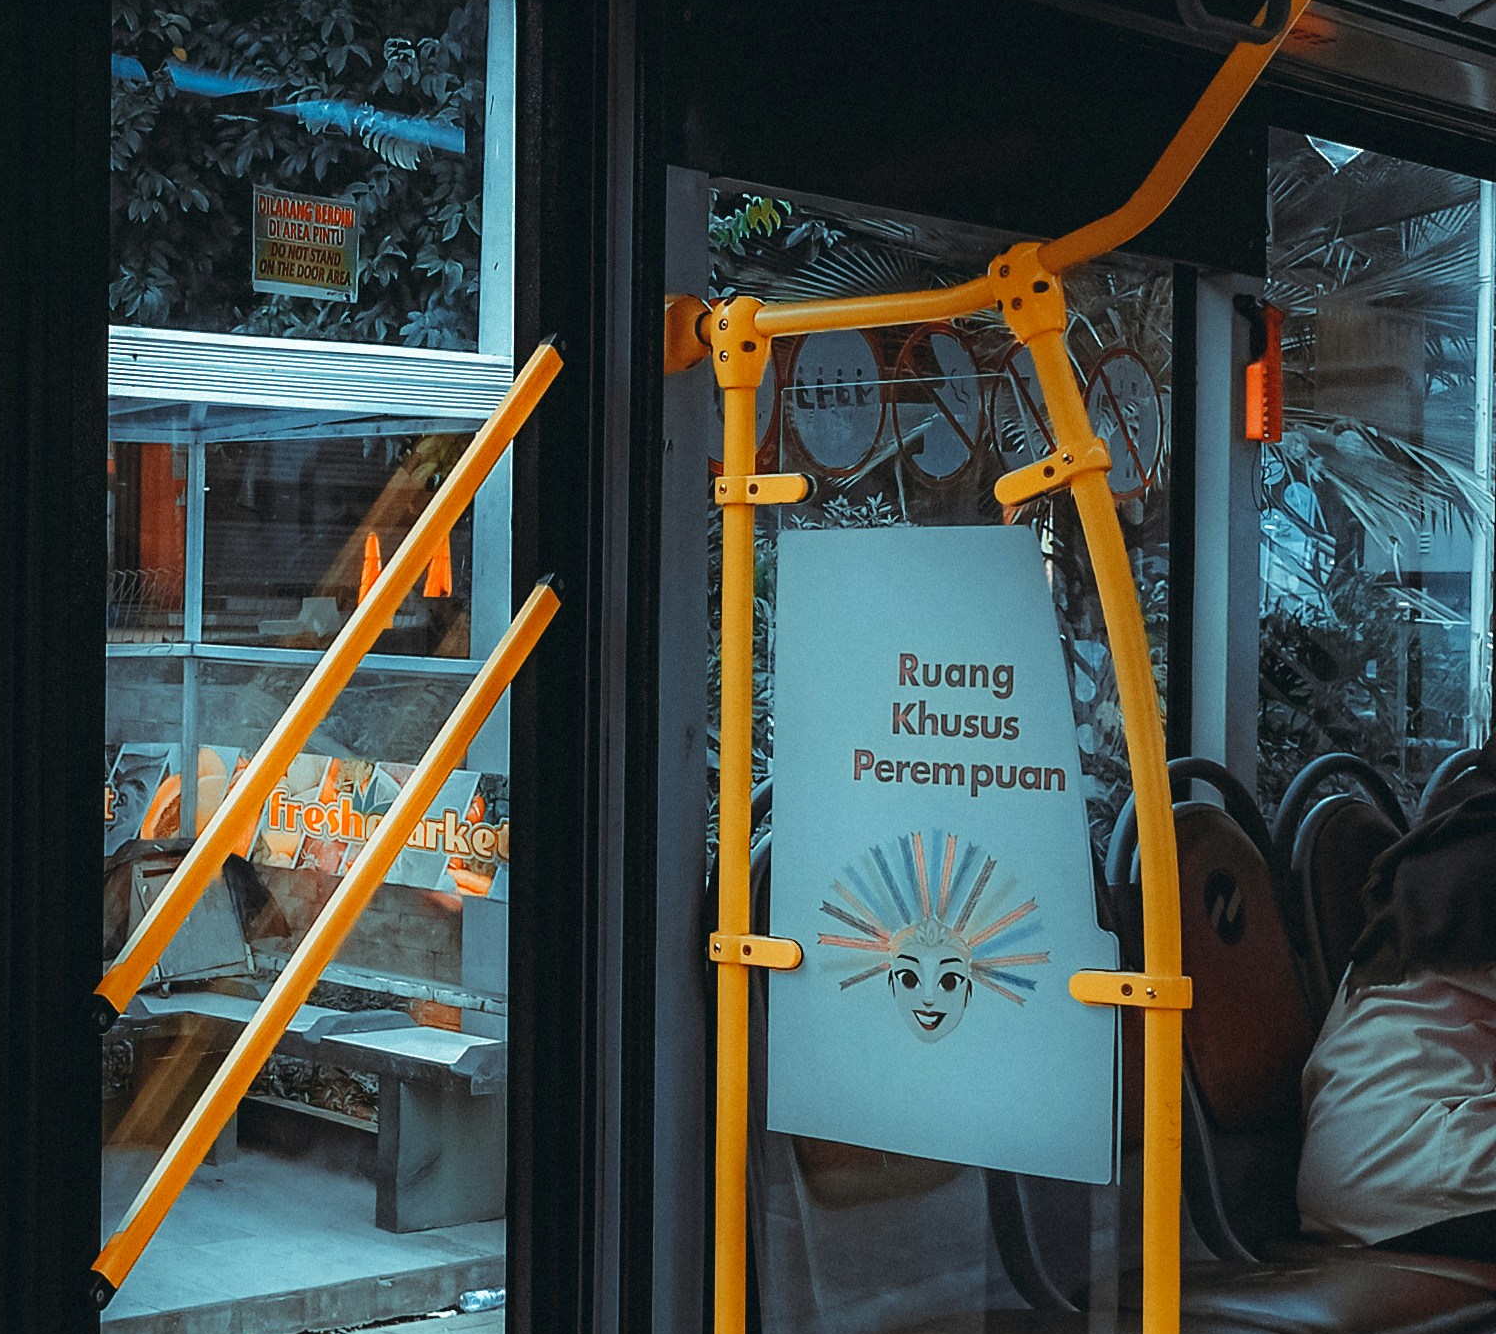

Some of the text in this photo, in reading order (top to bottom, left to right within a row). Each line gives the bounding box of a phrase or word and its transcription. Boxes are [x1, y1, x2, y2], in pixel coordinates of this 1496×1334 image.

[258, 194, 355, 229] DILARANG BERDIRI
[269, 218, 344, 247] DI AREA PINTU
[271, 242, 341, 266] DO NOT STAND
[260, 259, 351, 286] ON THE DOOR AREA
[899, 653, 1014, 699] Ruang
[892, 700, 1020, 740] Khusus
[853, 749, 1066, 797] Perempuan
